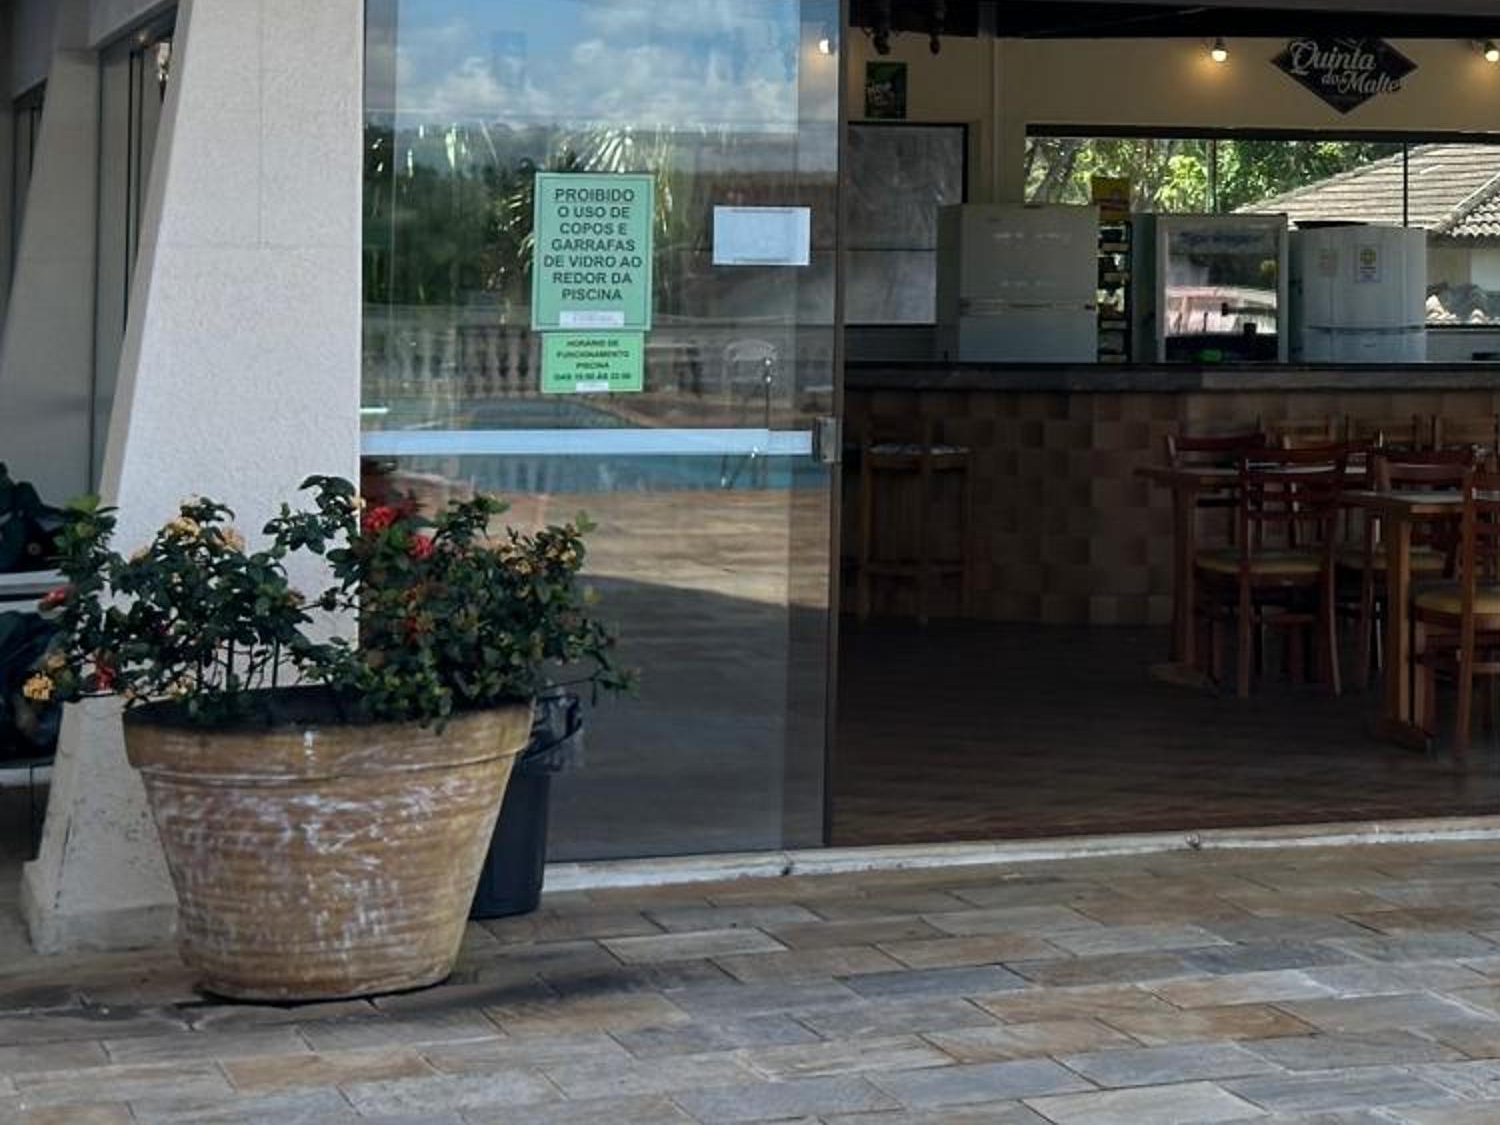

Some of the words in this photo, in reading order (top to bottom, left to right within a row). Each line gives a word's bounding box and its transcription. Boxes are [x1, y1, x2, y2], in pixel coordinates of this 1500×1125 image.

[1289, 40, 1376, 75] Quinta
[555, 188, 635, 202] PROIBIDO
[557, 206, 569, 218] O
[573, 206, 607, 218] USO
[611, 206, 631, 219] DE
[559, 222, 614, 234] COPOS
[618, 222, 628, 235] E
[551, 238, 636, 252] GARRAFAS
[543, 255, 565, 268] DE
[569, 255, 616, 268] VIDRO
[619, 256, 643, 268] AO
[552, 271, 607, 284] REDOR
[611, 271, 633, 284] DA
[561, 288, 623, 301] PISCINA
[556, 350, 629, 359] FUNCIONAMENTO
